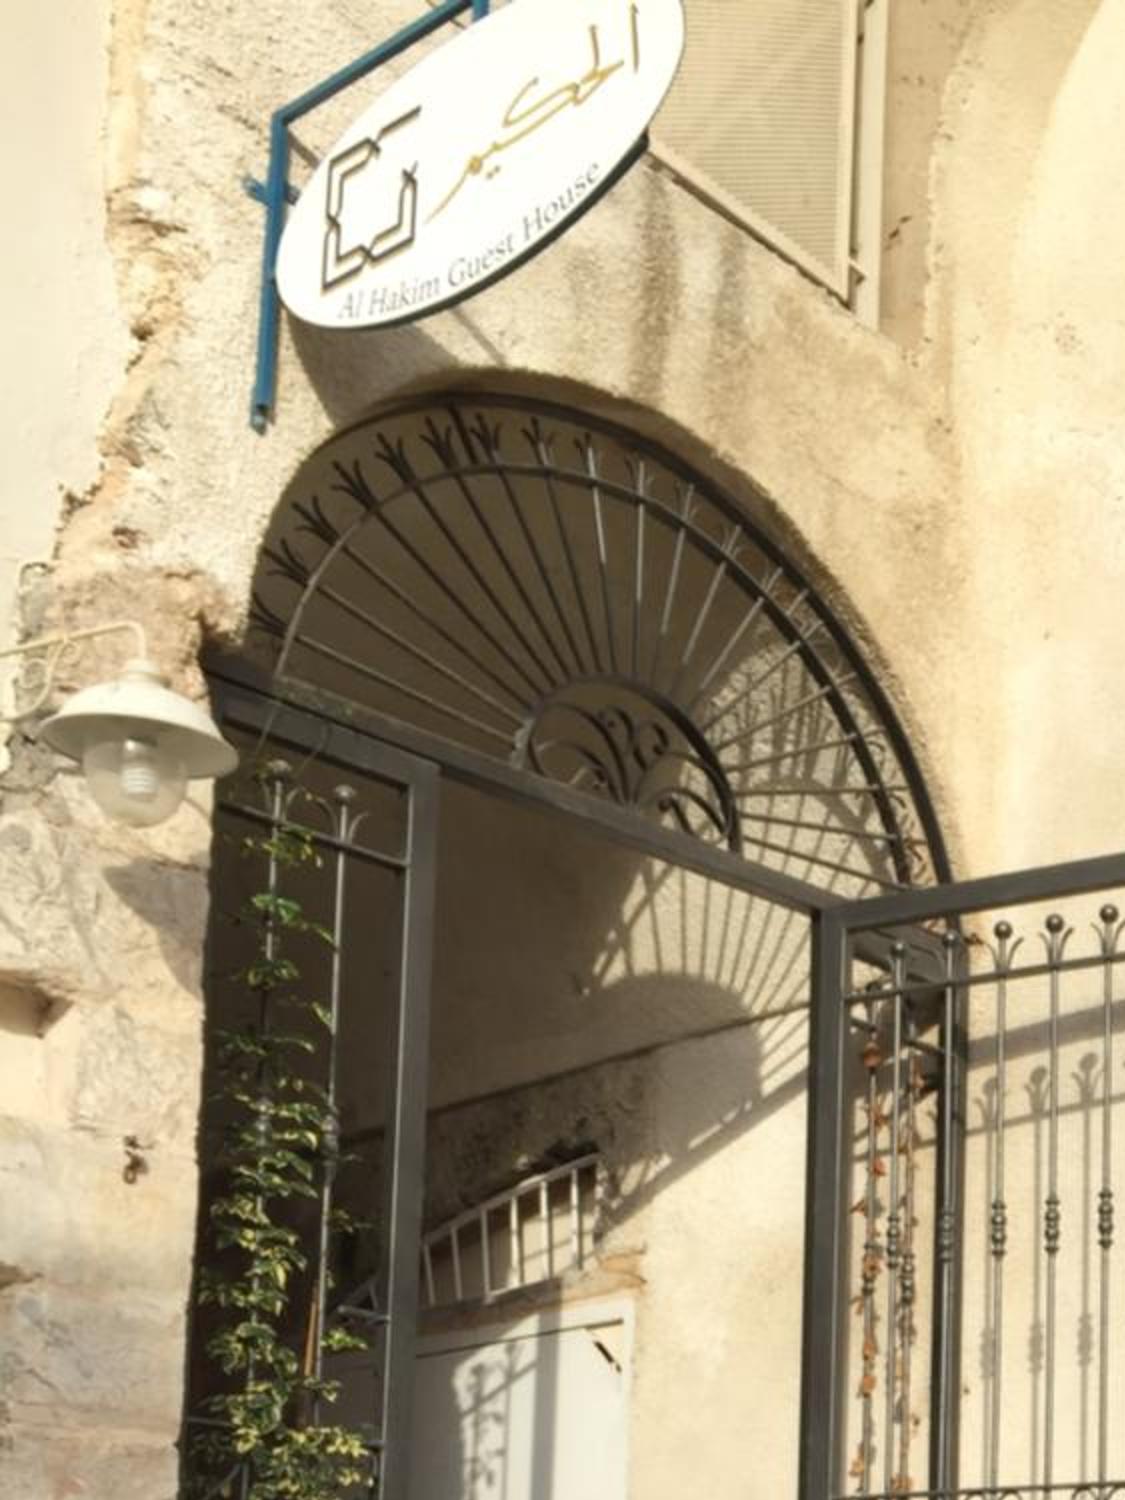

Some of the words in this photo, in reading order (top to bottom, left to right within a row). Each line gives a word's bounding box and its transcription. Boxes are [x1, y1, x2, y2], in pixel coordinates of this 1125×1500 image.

[337, 291, 363, 320] Al
[368, 273, 442, 317] Hakim
[447, 232, 517, 288] Guest
[522, 162, 600, 242] House
